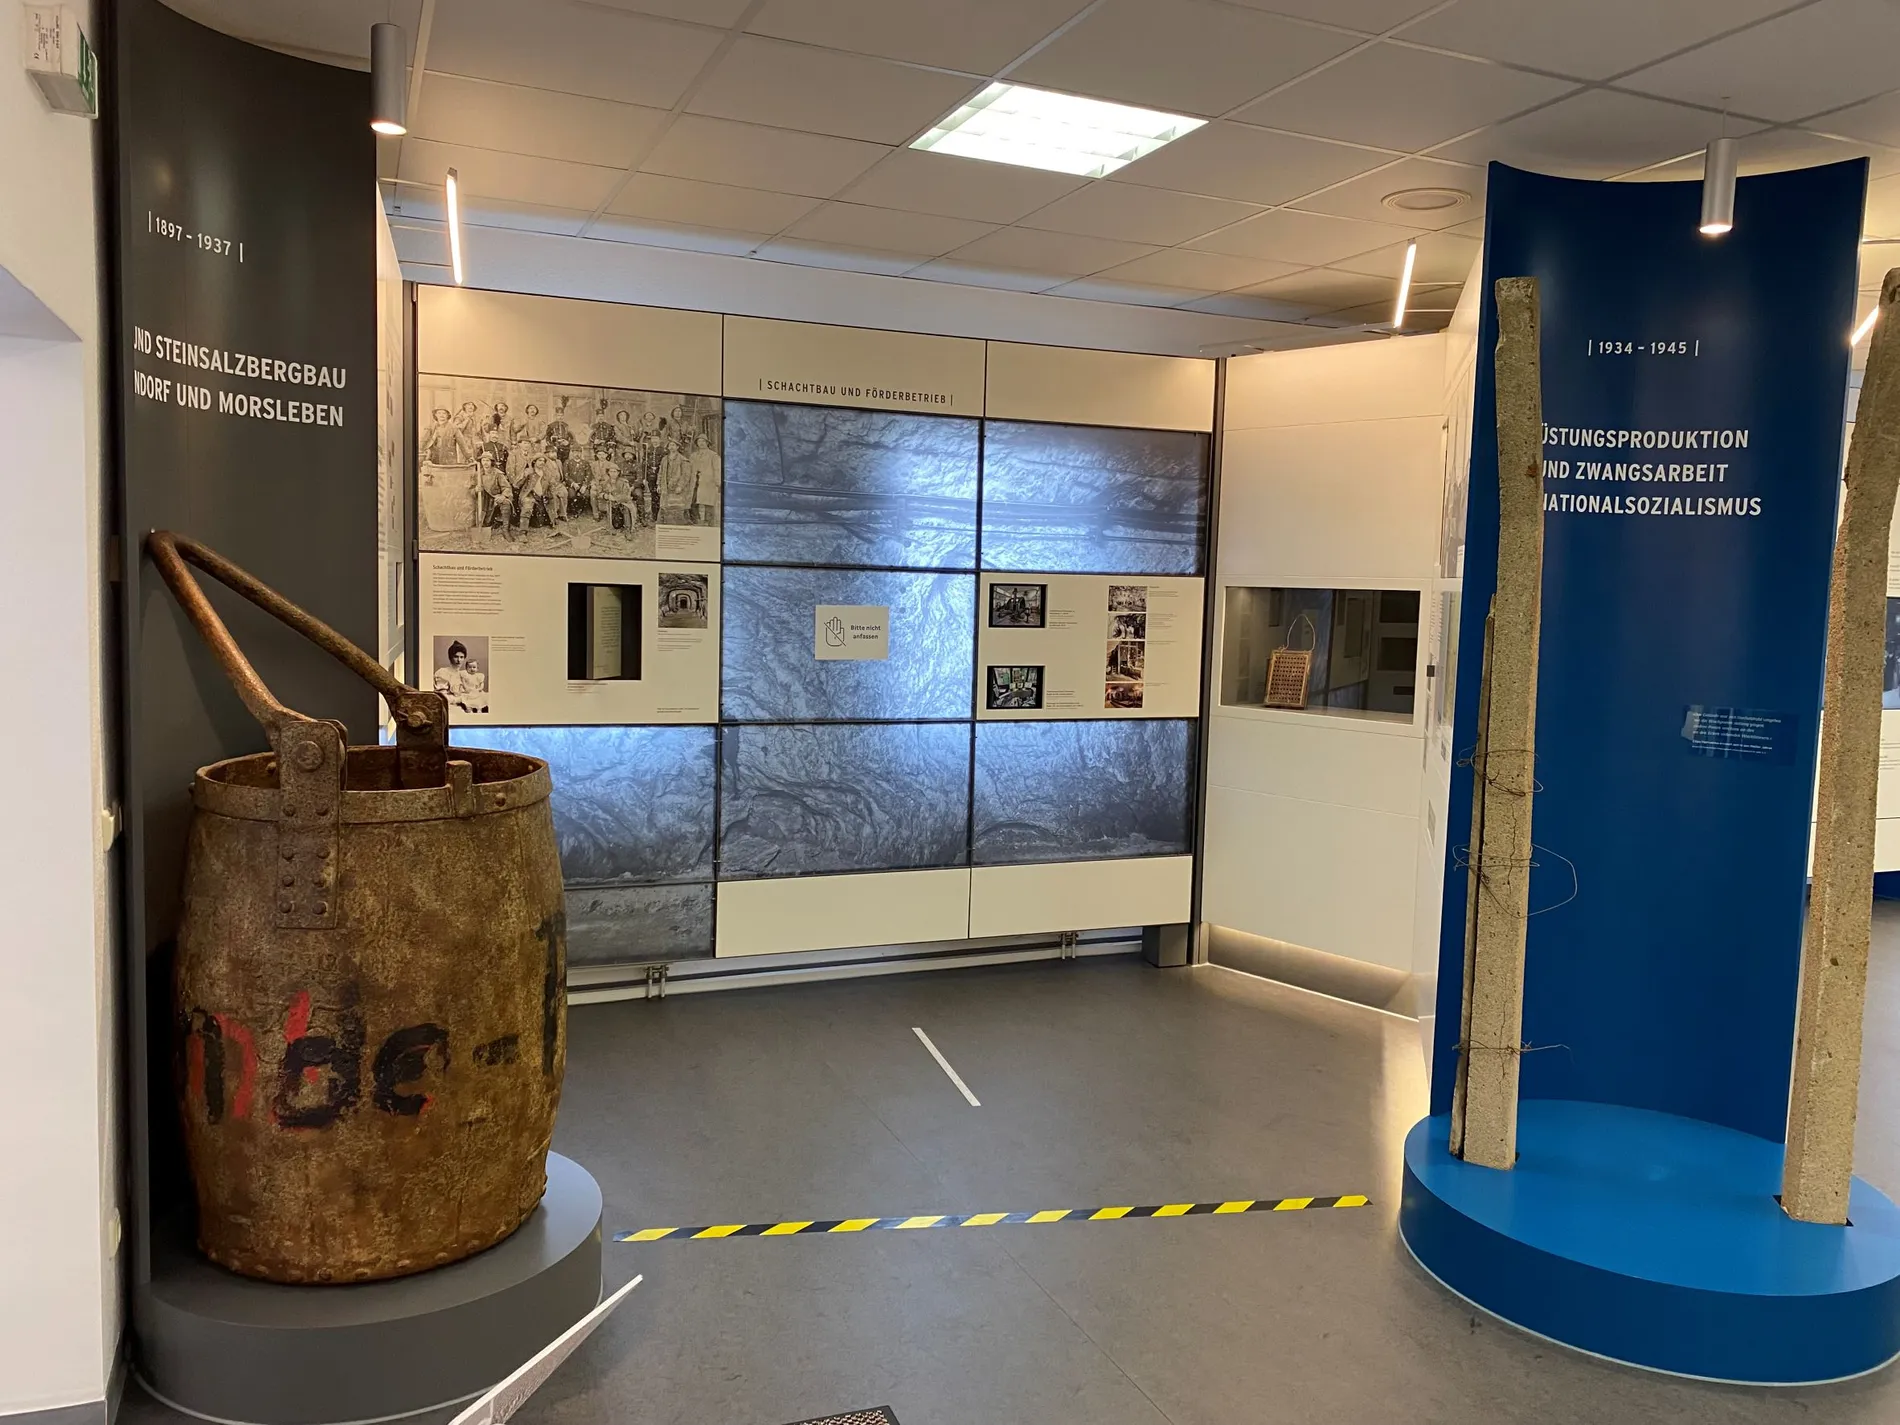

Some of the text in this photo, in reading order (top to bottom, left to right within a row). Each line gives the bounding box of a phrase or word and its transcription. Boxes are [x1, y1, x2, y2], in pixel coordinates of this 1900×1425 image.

[155, 216, 183, 242] 1897
[197, 232, 231, 256] 1937
[155, 334, 346, 390] STEINSALZBERGBAU
[1598, 341, 1634, 355] 1934
[1650, 341, 1687, 355] 1945
[133, 369, 344, 427] NDORF UND MORSLEBEN
[767, 380, 947, 404] SCHACHTBAU UND FÖRDERBETRIEB
[1575, 461, 1729, 483] ZWANGSARBEIT
